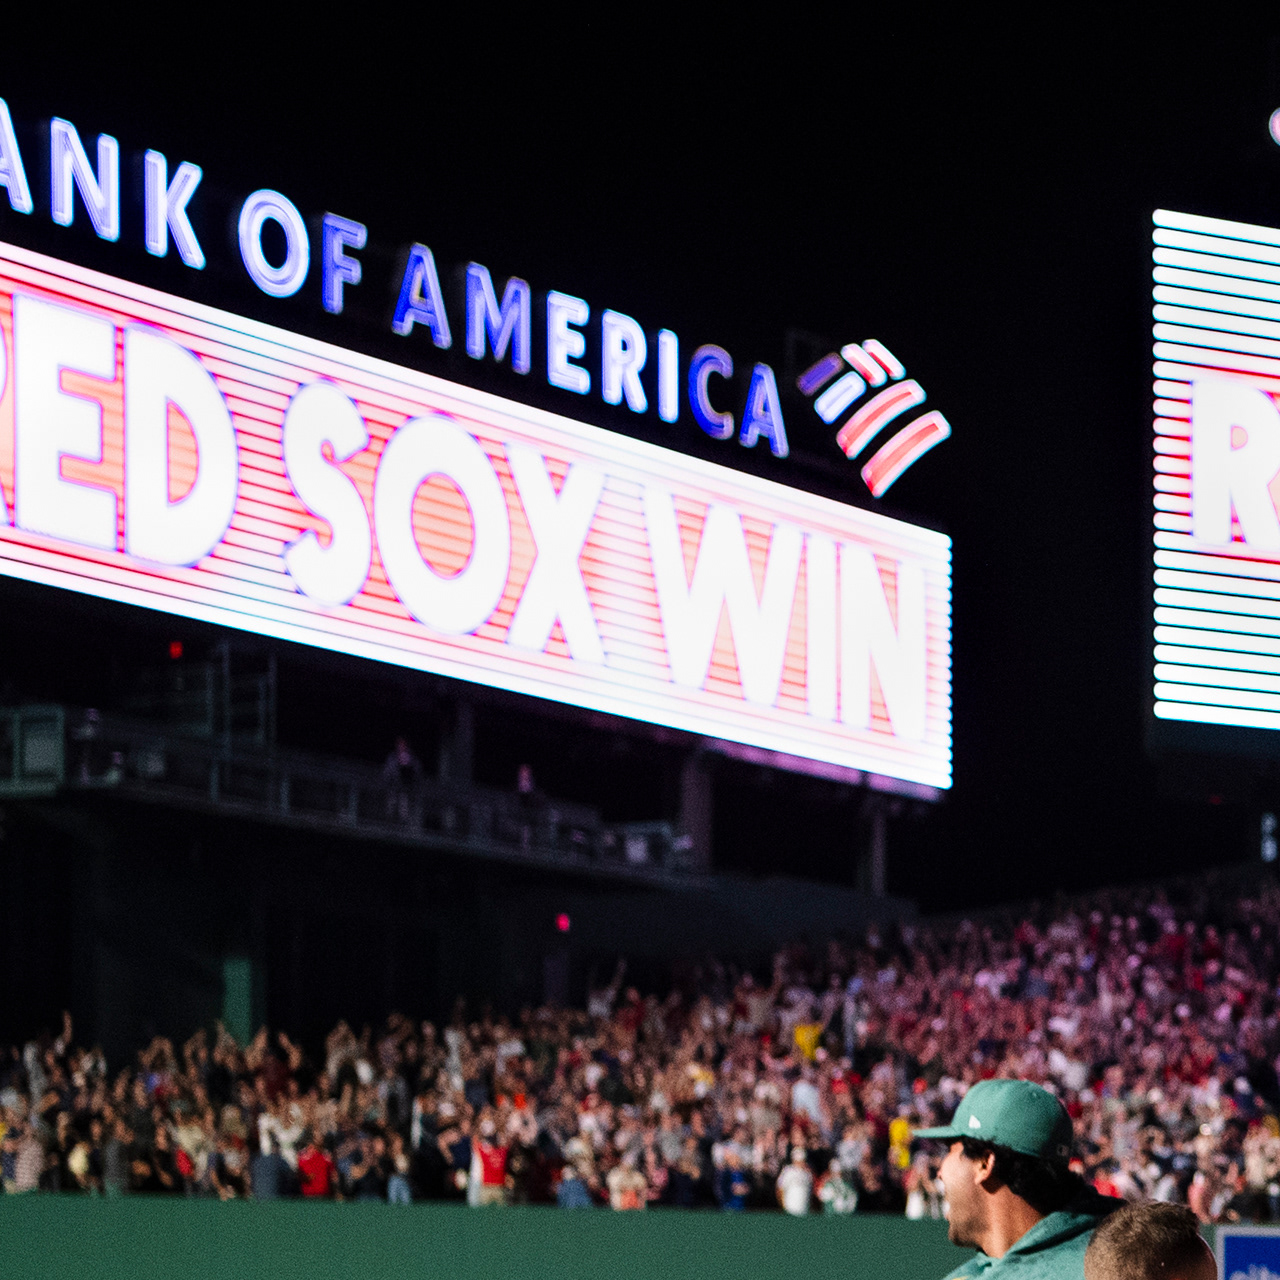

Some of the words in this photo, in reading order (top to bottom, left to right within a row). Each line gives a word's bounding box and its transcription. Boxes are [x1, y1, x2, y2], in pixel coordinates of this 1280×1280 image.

[238, 189, 367, 314] OF
[392, 242, 789, 457] AMERICA
[0, 293, 239, 568] ED
[281, 377, 608, 664] SOX
[641, 482, 927, 742] WIN
